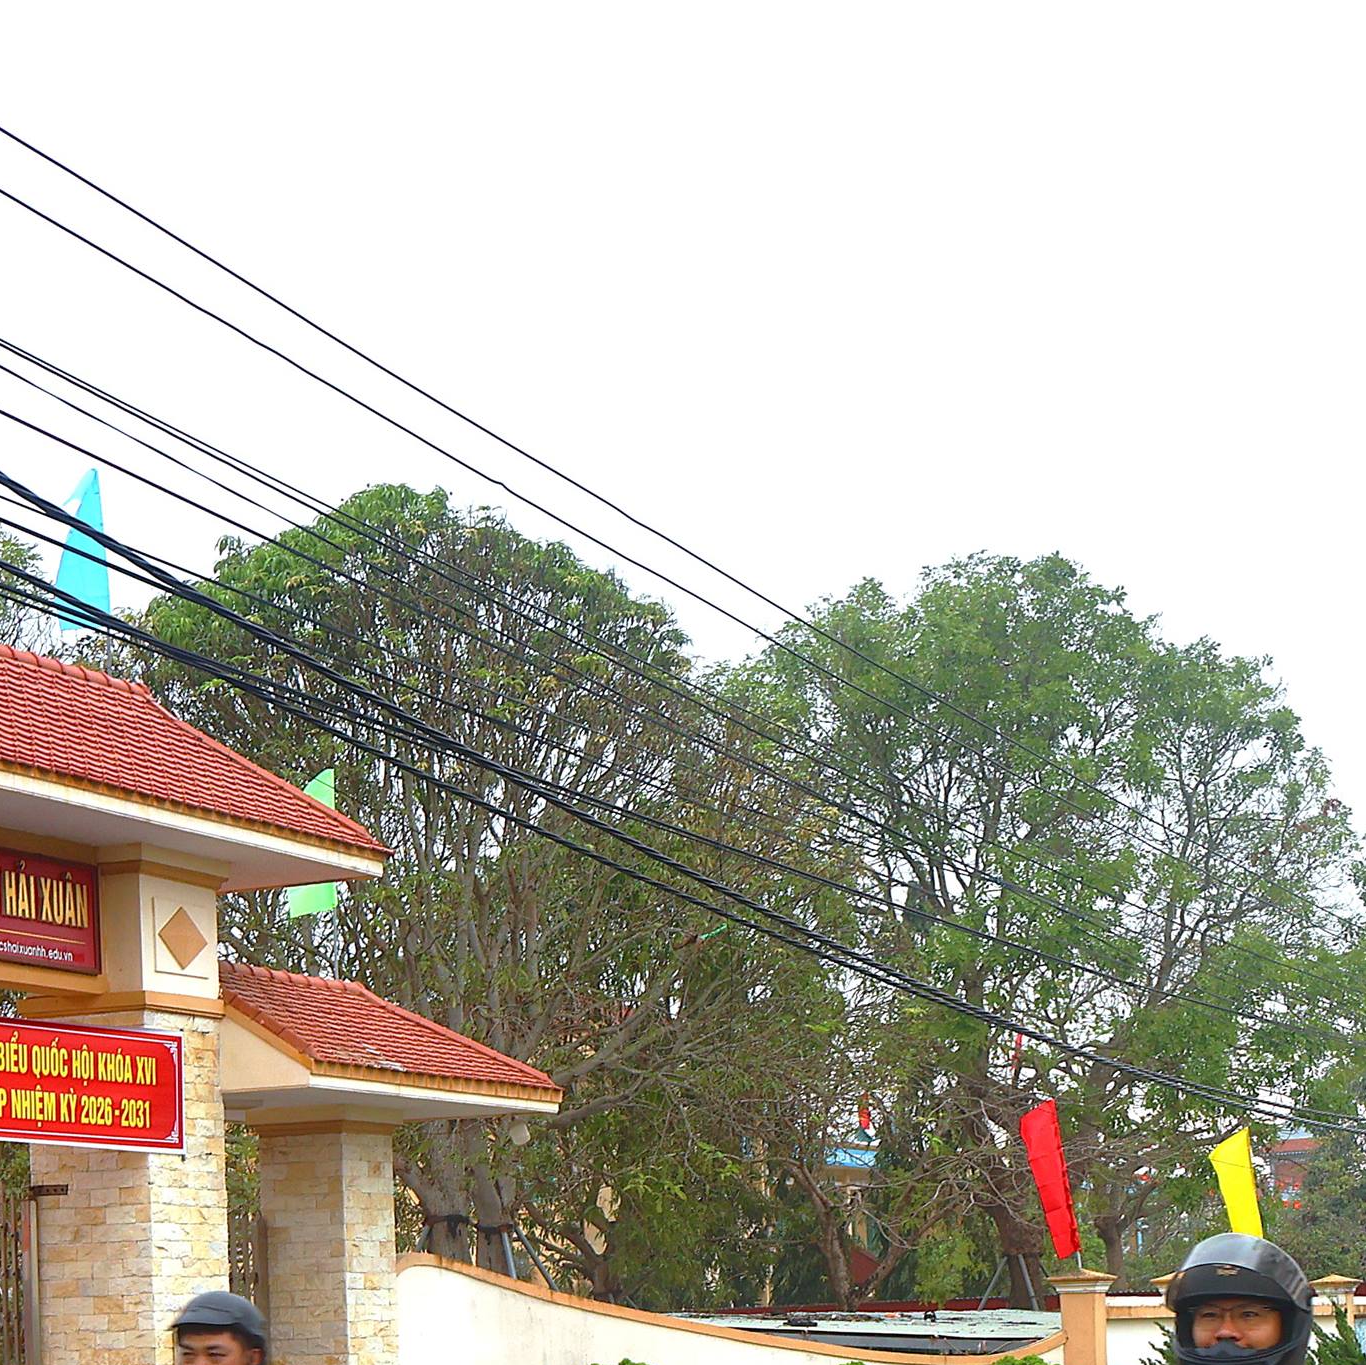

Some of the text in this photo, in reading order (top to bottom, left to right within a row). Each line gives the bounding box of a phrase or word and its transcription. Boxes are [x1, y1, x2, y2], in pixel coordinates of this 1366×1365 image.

[4, 859, 36, 920] HẢI
[40, 871, 89, 928] XUÂN
[31, 1036, 69, 1079] QUỐC
[72, 1043, 94, 1086] HỘI
[98, 1047, 133, 1084] KHÓA
[136, 1055, 157, 1086] XVI
[11, 1084, 57, 1127] NHIỆM
[60, 1087, 77, 1124] KỲ
